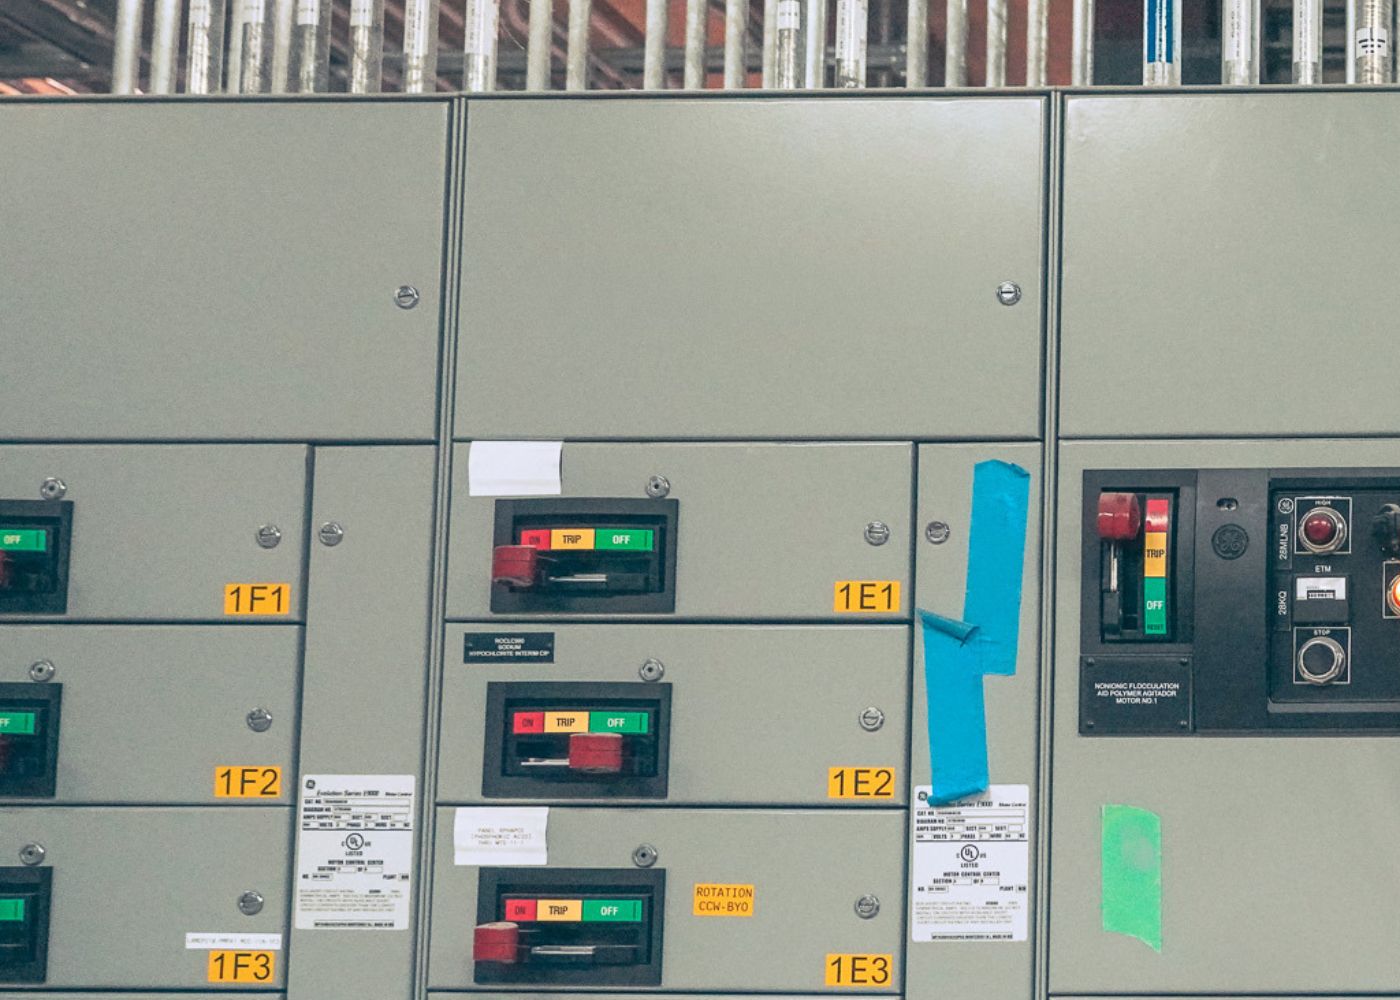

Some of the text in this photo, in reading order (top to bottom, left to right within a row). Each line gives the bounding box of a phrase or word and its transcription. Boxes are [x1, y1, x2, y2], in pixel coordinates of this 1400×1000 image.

[3, 535, 21, 545] OFF
[562, 534, 581, 544] TRIP
[612, 535, 631, 545] OFF
[1146, 549, 1165, 558] TRIP
[1314, 565, 1332, 573] ETM
[229, 586, 285, 612] 1F1
[839, 583, 893, 610] 1E1
[1146, 600, 1164, 610] OFF
[556, 718, 575, 728] TRIP
[607, 717, 626, 728] OFF
[220, 768, 278, 796] 1F2
[833, 769, 892, 796] 1E2
[696, 886, 753, 898] ROTATION
[548, 905, 568, 915] TRIP
[600, 906, 618, 916] OFF
[214, 953, 270, 981] 1F3
[831, 956, 889, 984] 1E3
